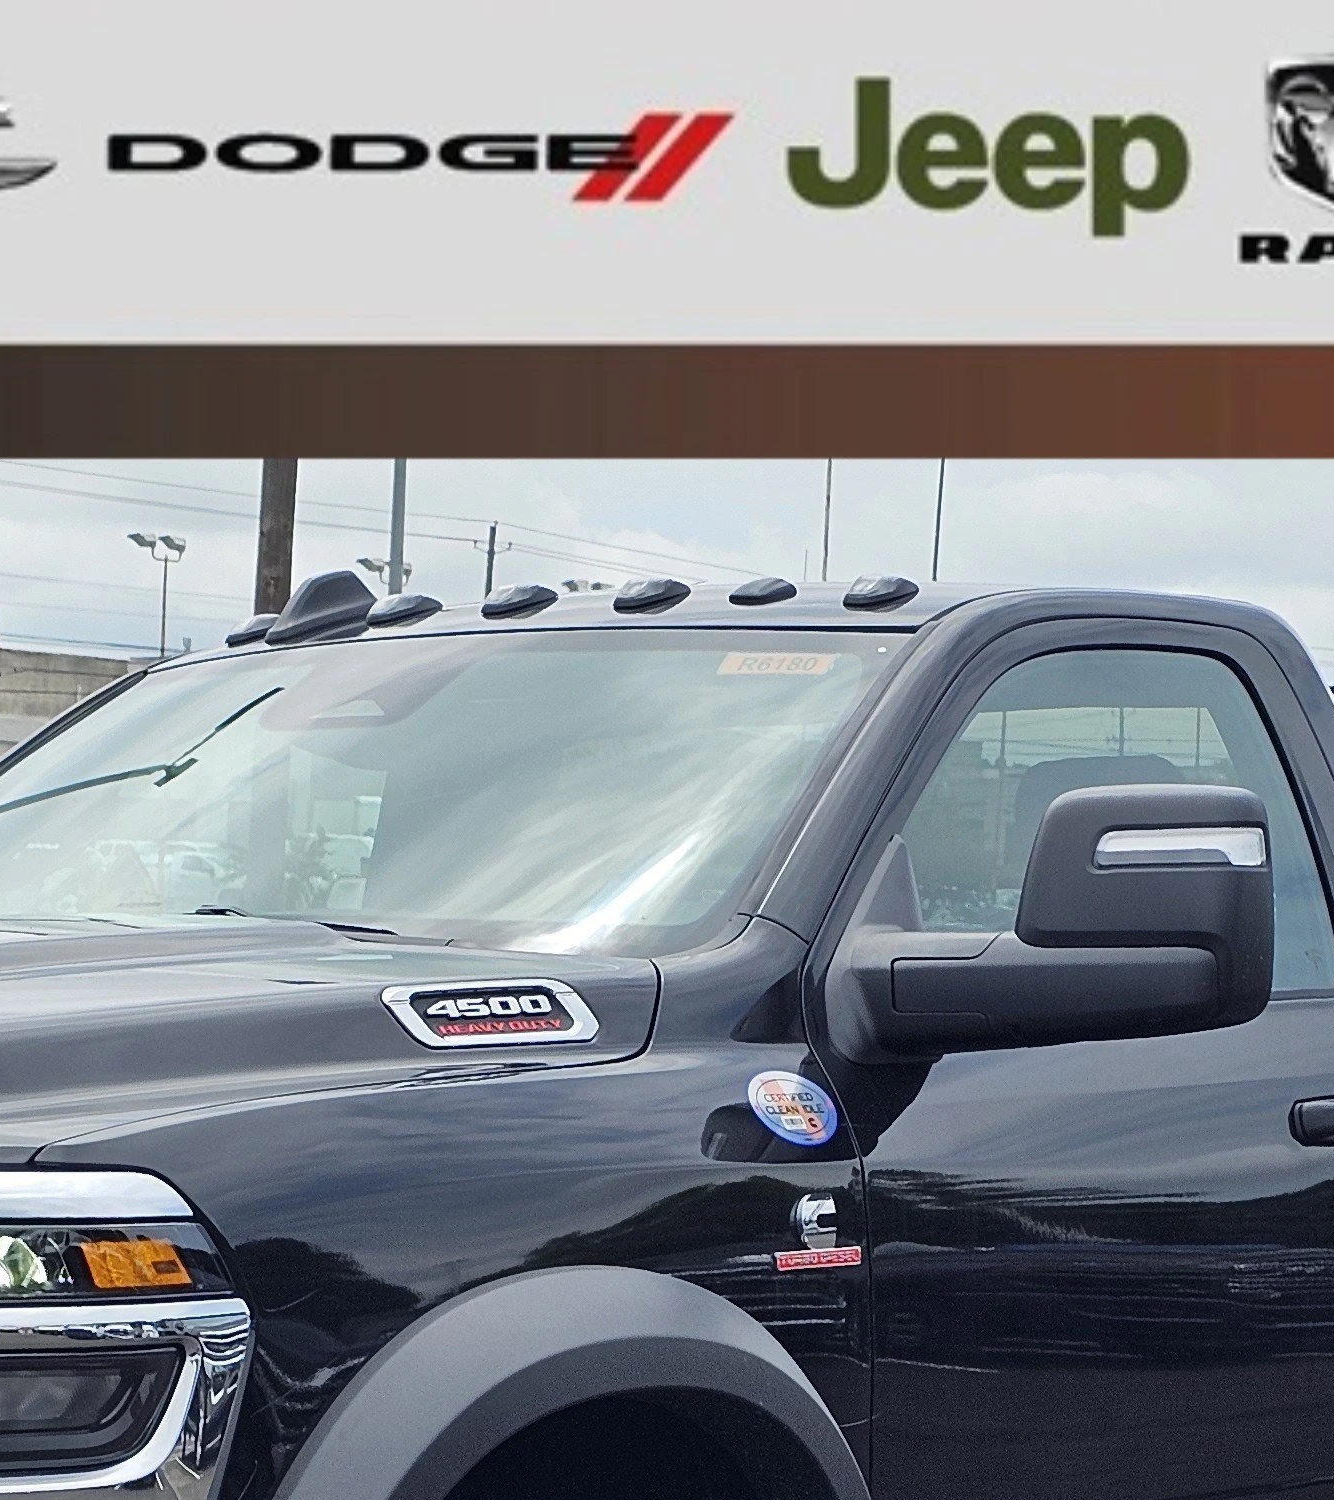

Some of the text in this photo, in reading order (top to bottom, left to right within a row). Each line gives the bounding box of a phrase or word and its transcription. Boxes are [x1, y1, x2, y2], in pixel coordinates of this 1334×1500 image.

[737, 656, 820, 672] R6180
[426, 994, 553, 1019] 4500
[437, 1017, 563, 1036] HEAVY DUTY
[765, 1104, 800, 1115] CLEAN
